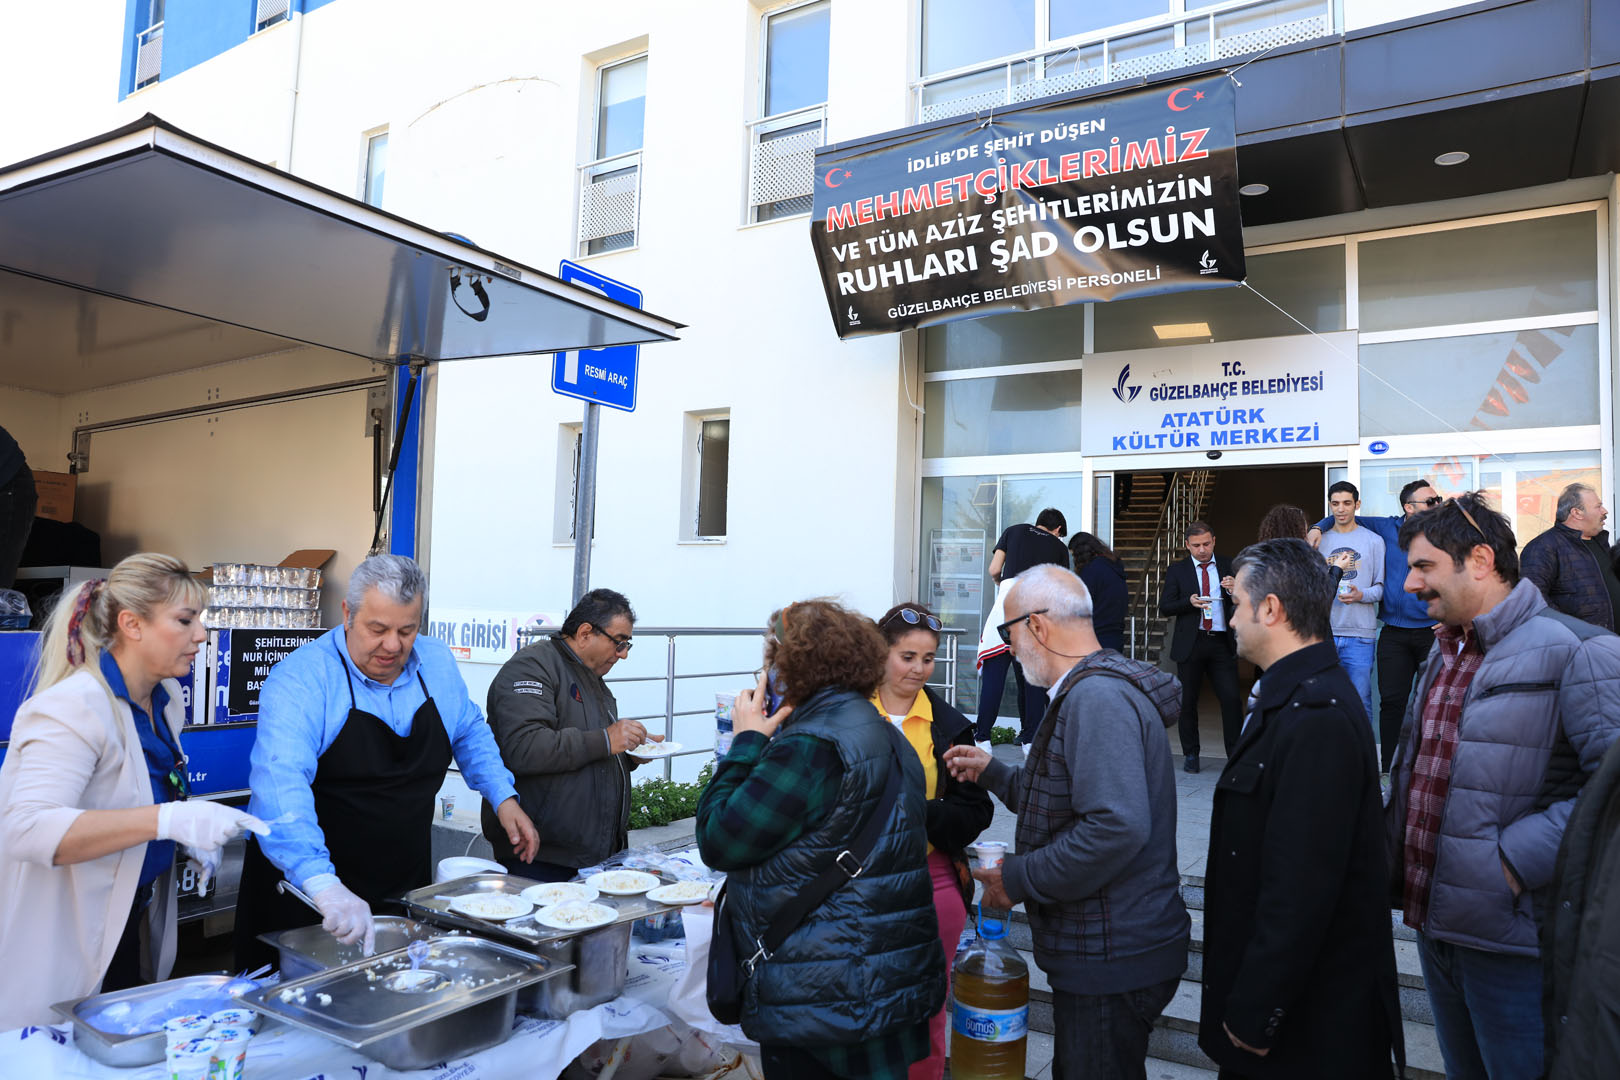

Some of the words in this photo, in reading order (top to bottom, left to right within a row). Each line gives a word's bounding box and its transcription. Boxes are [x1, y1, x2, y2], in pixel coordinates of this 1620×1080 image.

[984, 130, 1035, 158] ŞEHİT
[1040, 117, 1106, 143] DÜŞEN
[826, 125, 1211, 233] MEHMETÇİKLERİMİZ
[831, 238, 861, 263] VE
[865, 226, 918, 255] TÜM
[925, 212, 985, 243] AZİZ
[991, 173, 1213, 231] ŞEHİTLERİMİZİN
[837, 245, 979, 296] RUHLARI
[990, 230, 1058, 274] ŞAD
[1073, 207, 1217, 254] OLSUN
[887, 291, 981, 320] GÜZELBAHÇE
[984, 274, 1063, 302] BELEDİYESİ
[1066, 264, 1161, 290] PERSONELİ
[585, 364, 607, 381] RESMİ
[607, 371, 628, 389] ARAÇ
[1221, 361, 1246, 376] T.C.
[1150, 380, 1238, 402] GÜZELBAHÇE
[1241, 370, 1324, 395] BELEDİYESİ
[1160, 406, 1265, 428] ATATÜRK
[1112, 429, 1200, 450] KÜLTÜR
[1210, 421, 1320, 446] MERKEZİ
[254, 637, 315, 650] ŞEHİTLERİMİ
[429, 621, 456, 646] ARK
[461, 618, 507, 652] GİRİŞİ
[242, 652, 262, 662] NUR
